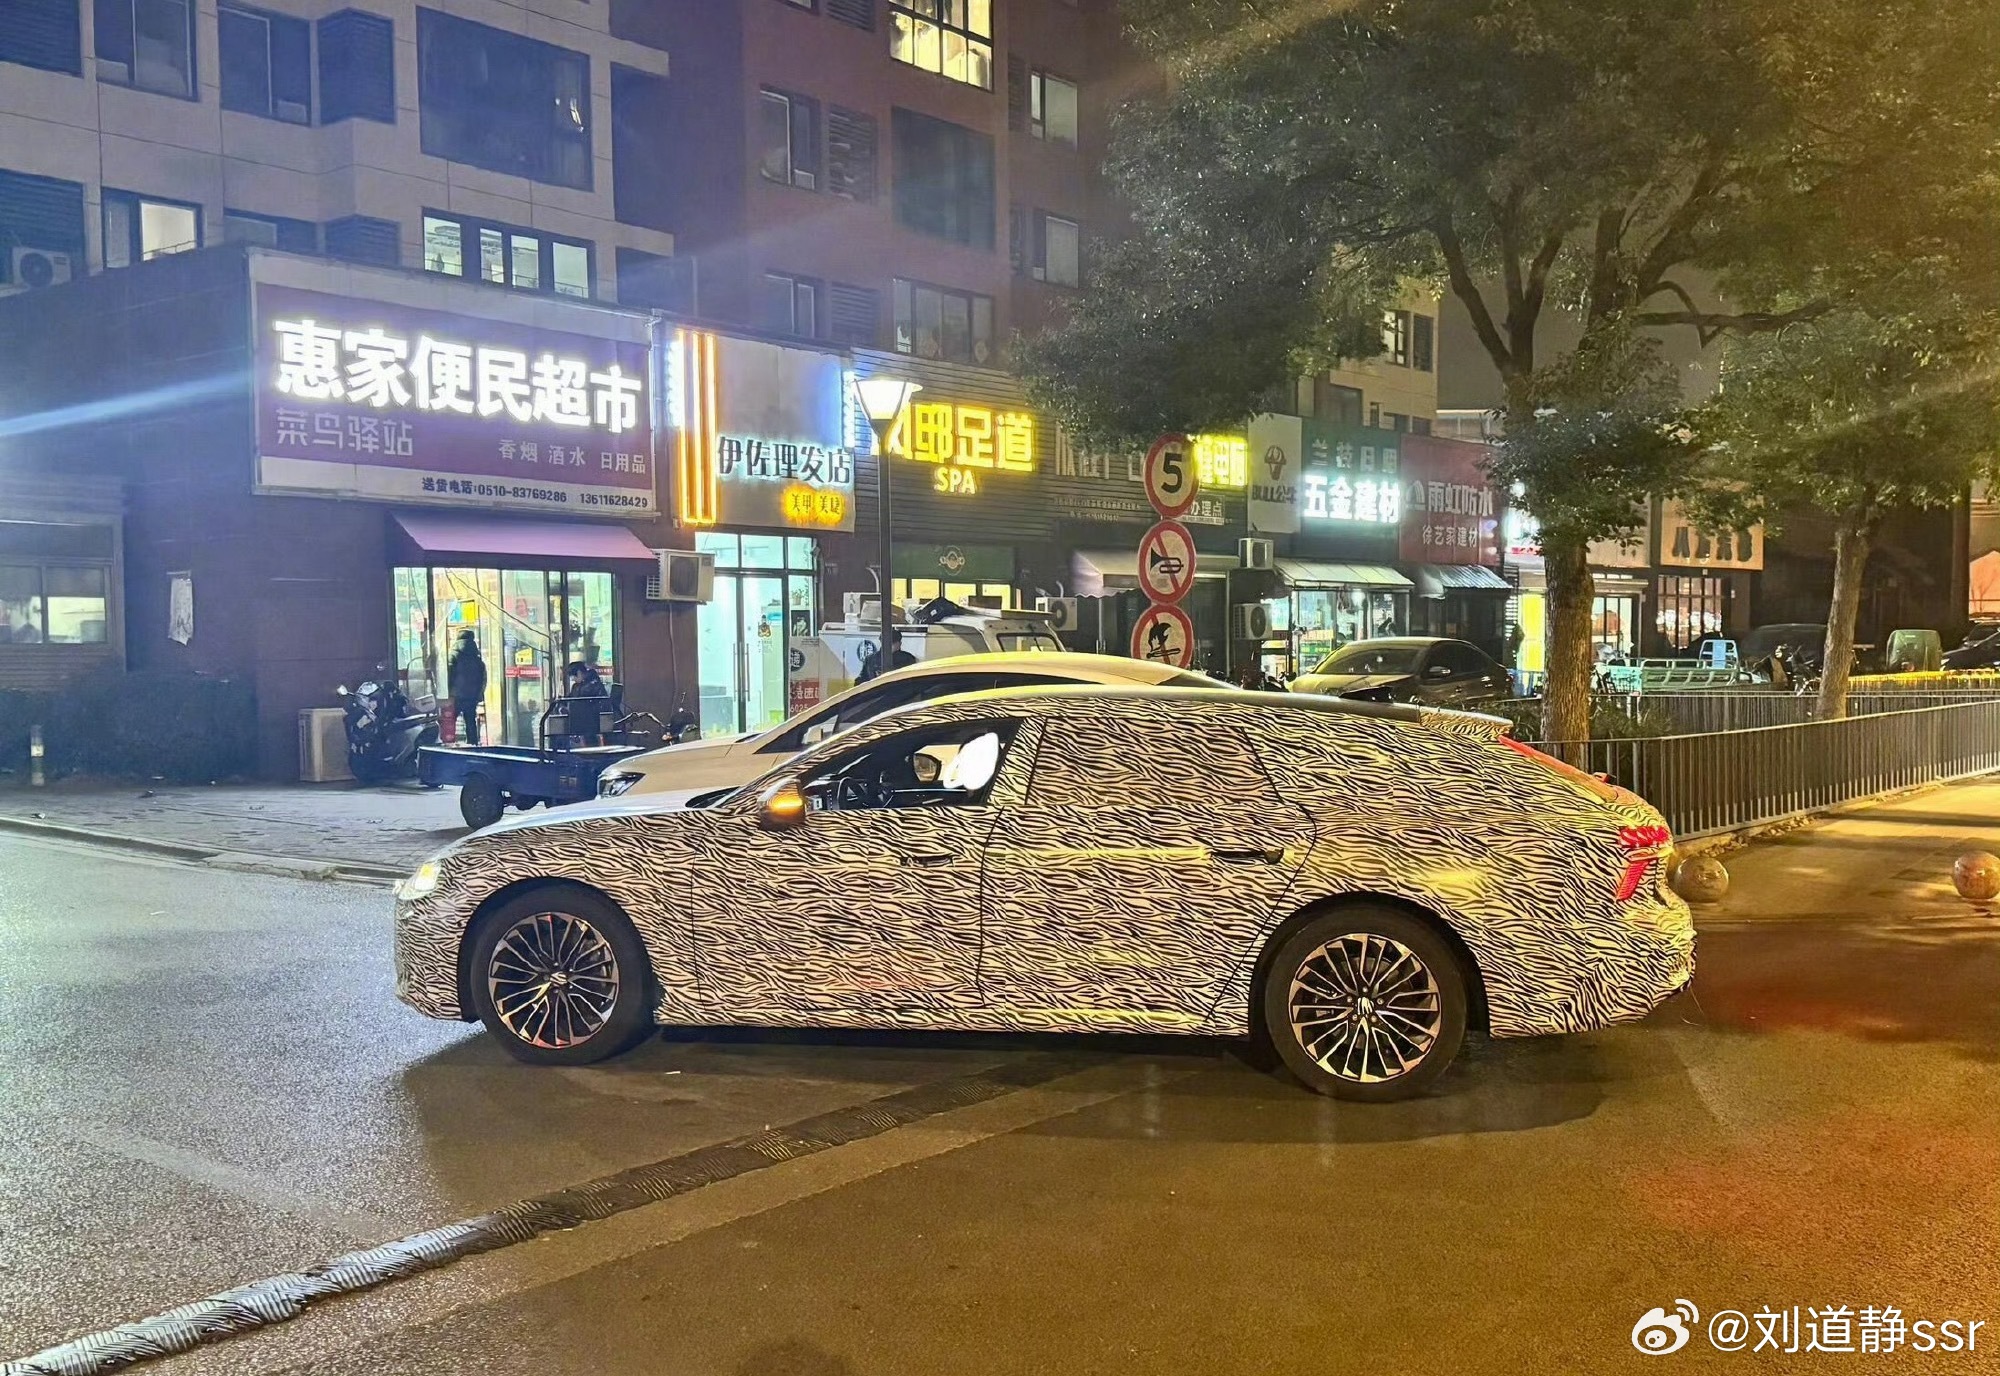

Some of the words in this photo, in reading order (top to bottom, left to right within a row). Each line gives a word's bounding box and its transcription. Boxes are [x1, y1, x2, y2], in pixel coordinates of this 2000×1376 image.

[273, 319, 642, 434] 惠家便民超市
[276, 407, 414, 457] 菜鸟驿站
[498, 439, 539, 462] 香烟
[548, 444, 587, 467] 酒水
[600, 452, 647, 475] 日用品
[718, 436, 852, 484] 伊佐理发店
[1161, 452, 1183, 494] 5
[579, 492, 649, 509] 13611628429
[934, 467, 976, 495] SPA
[1303, 474, 1401, 523] 五金建材
[1427, 481, 1494, 517] 雨虹防水
[1422, 524, 1478, 547] 徐艺家建材
